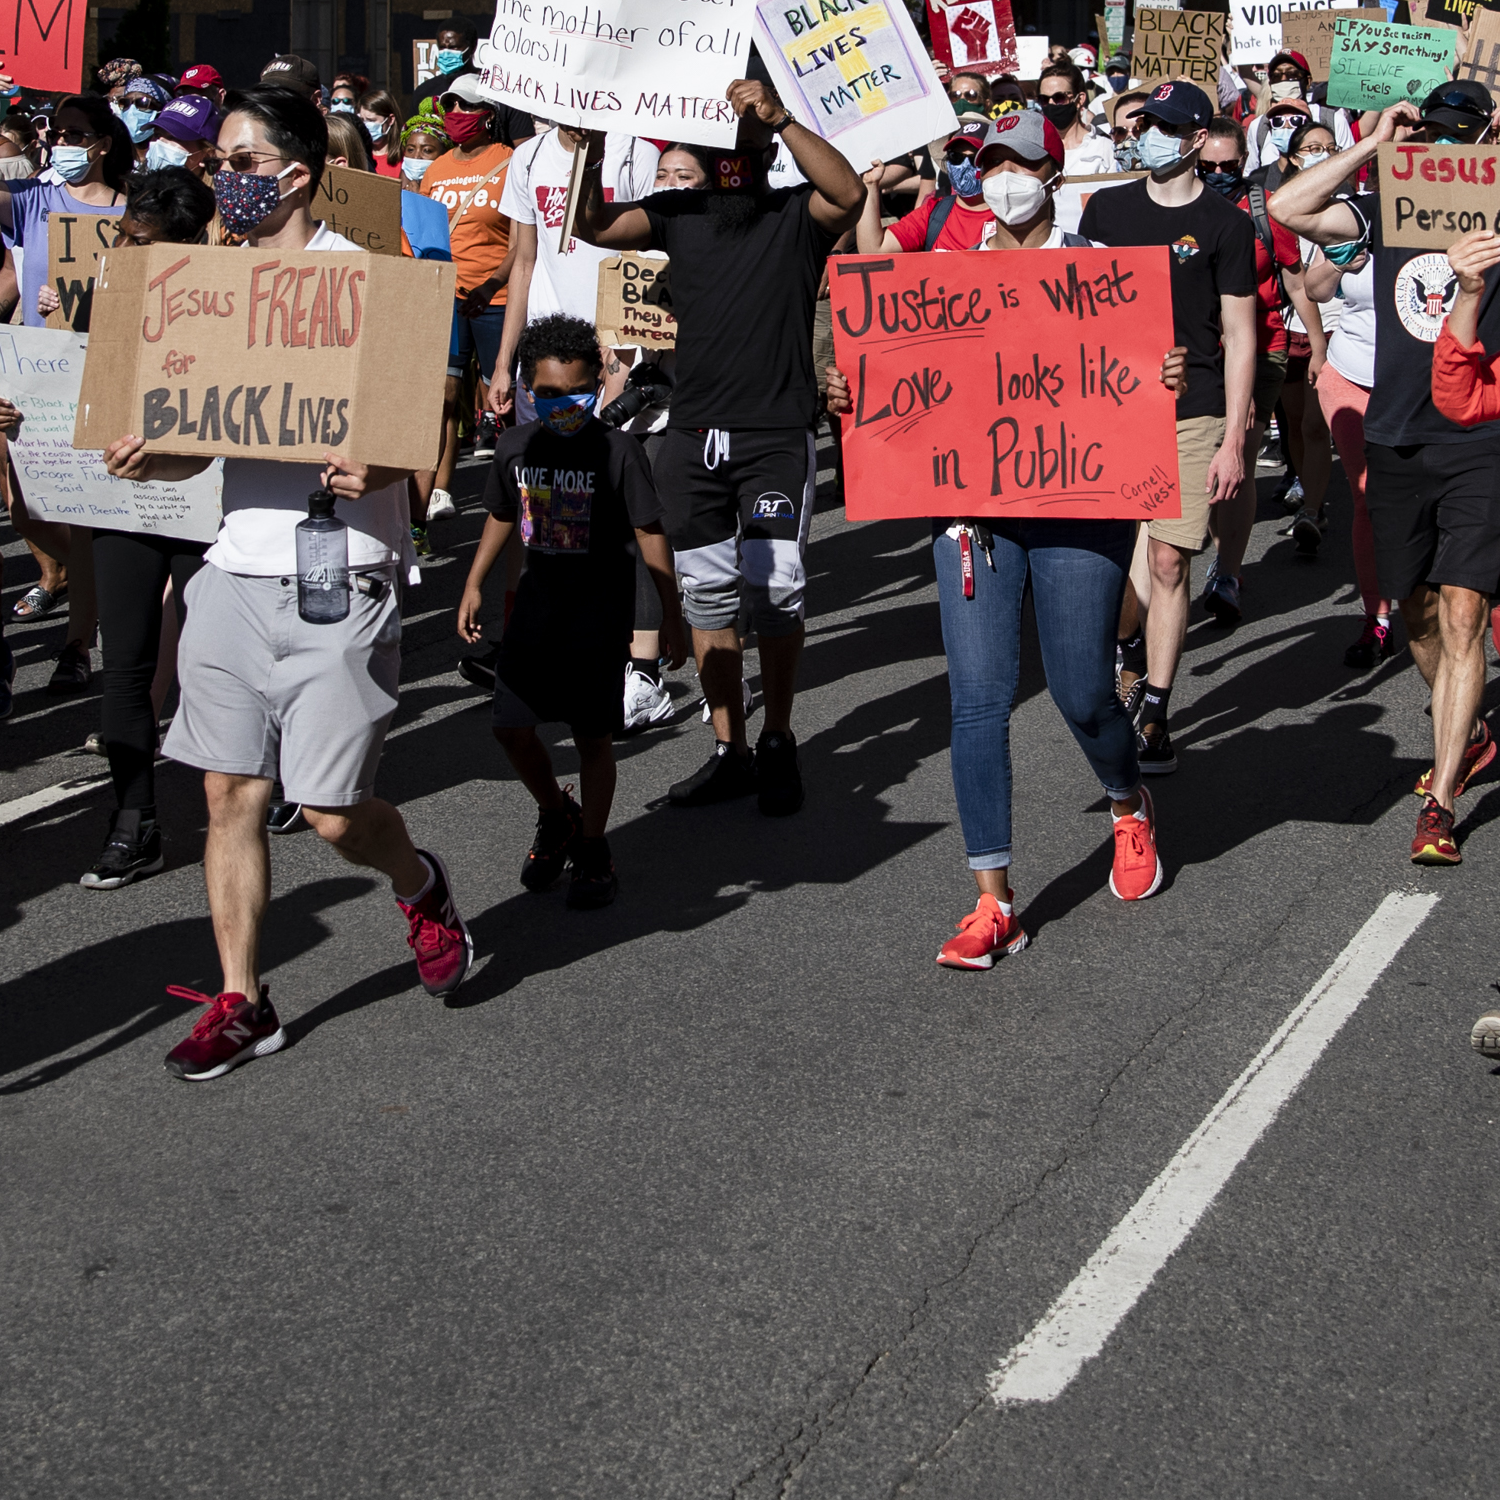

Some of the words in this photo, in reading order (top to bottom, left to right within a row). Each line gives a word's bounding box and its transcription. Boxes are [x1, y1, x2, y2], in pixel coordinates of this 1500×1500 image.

[1139, 9, 1222, 36] BLACK
[1284, 11, 1352, 21] INJUSTICE
[542, 6, 648, 44] mother
[658, 20, 696, 47] of
[696, 28, 741, 56] all
[1234, 37, 1261, 50] hate
[792, 28, 868, 78] LIVES
[1145, 35, 1217, 61] LIVES
[1341, 39, 1378, 53] SAY
[1134, 55, 1217, 82] MATTER
[1334, 57, 1405, 78] SILENCE
[480, 64, 546, 102] #BLACK
[554, 82, 622, 112] LIVES
[820, 64, 901, 114] MATTER
[1361, 80, 1391, 95] Fuels
[1391, 145, 1497, 185] Jesus
[1395, 196, 1486, 234] Person
[248, 259, 366, 350] FREAKS
[835, 258, 992, 338] Justice
[996, 283, 1020, 309] is
[623, 306, 662, 327] They
[161, 349, 196, 378] for
[854, 353, 953, 428] Love
[995, 352, 1065, 408] looks
[1080, 343, 1142, 407] like
[31, 396, 64, 410] Black
[143, 383, 271, 447] BLACK
[278, 381, 349, 447] LIVES
[13, 438, 49, 448] Martin
[43, 425, 69, 433] world
[932, 447, 968, 489] in
[987, 416, 1104, 497] Public
[55, 484, 84, 493] said
[516, 466, 548, 490] LOVE
[552, 468, 596, 493] MORE
[1120, 464, 1169, 501] Cornell
[1139, 481, 1176, 512] West
